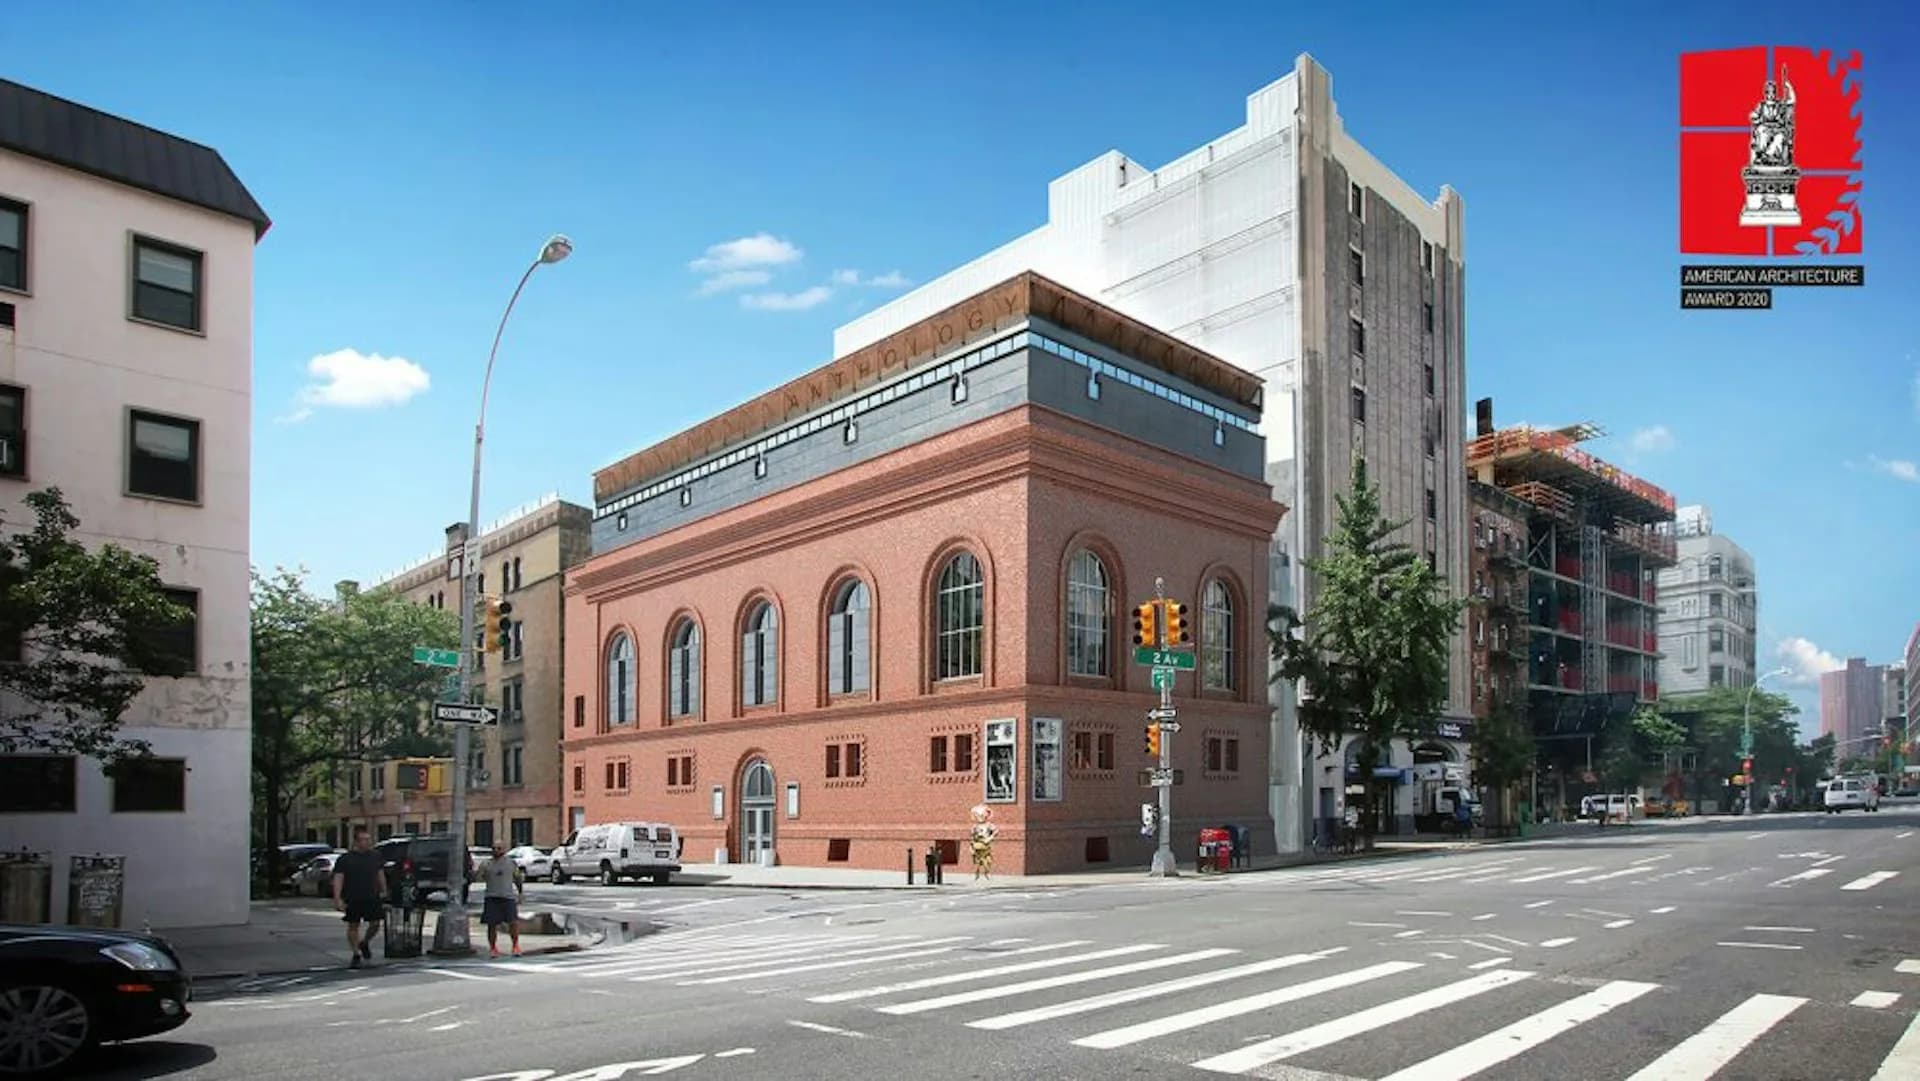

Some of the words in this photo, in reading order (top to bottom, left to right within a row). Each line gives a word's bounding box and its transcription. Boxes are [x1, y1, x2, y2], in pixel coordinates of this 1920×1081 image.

[785, 292, 1018, 410] ANTHOLOGY
[1152, 652, 1162, 664] 2
[1163, 654, 1179, 666] Av
